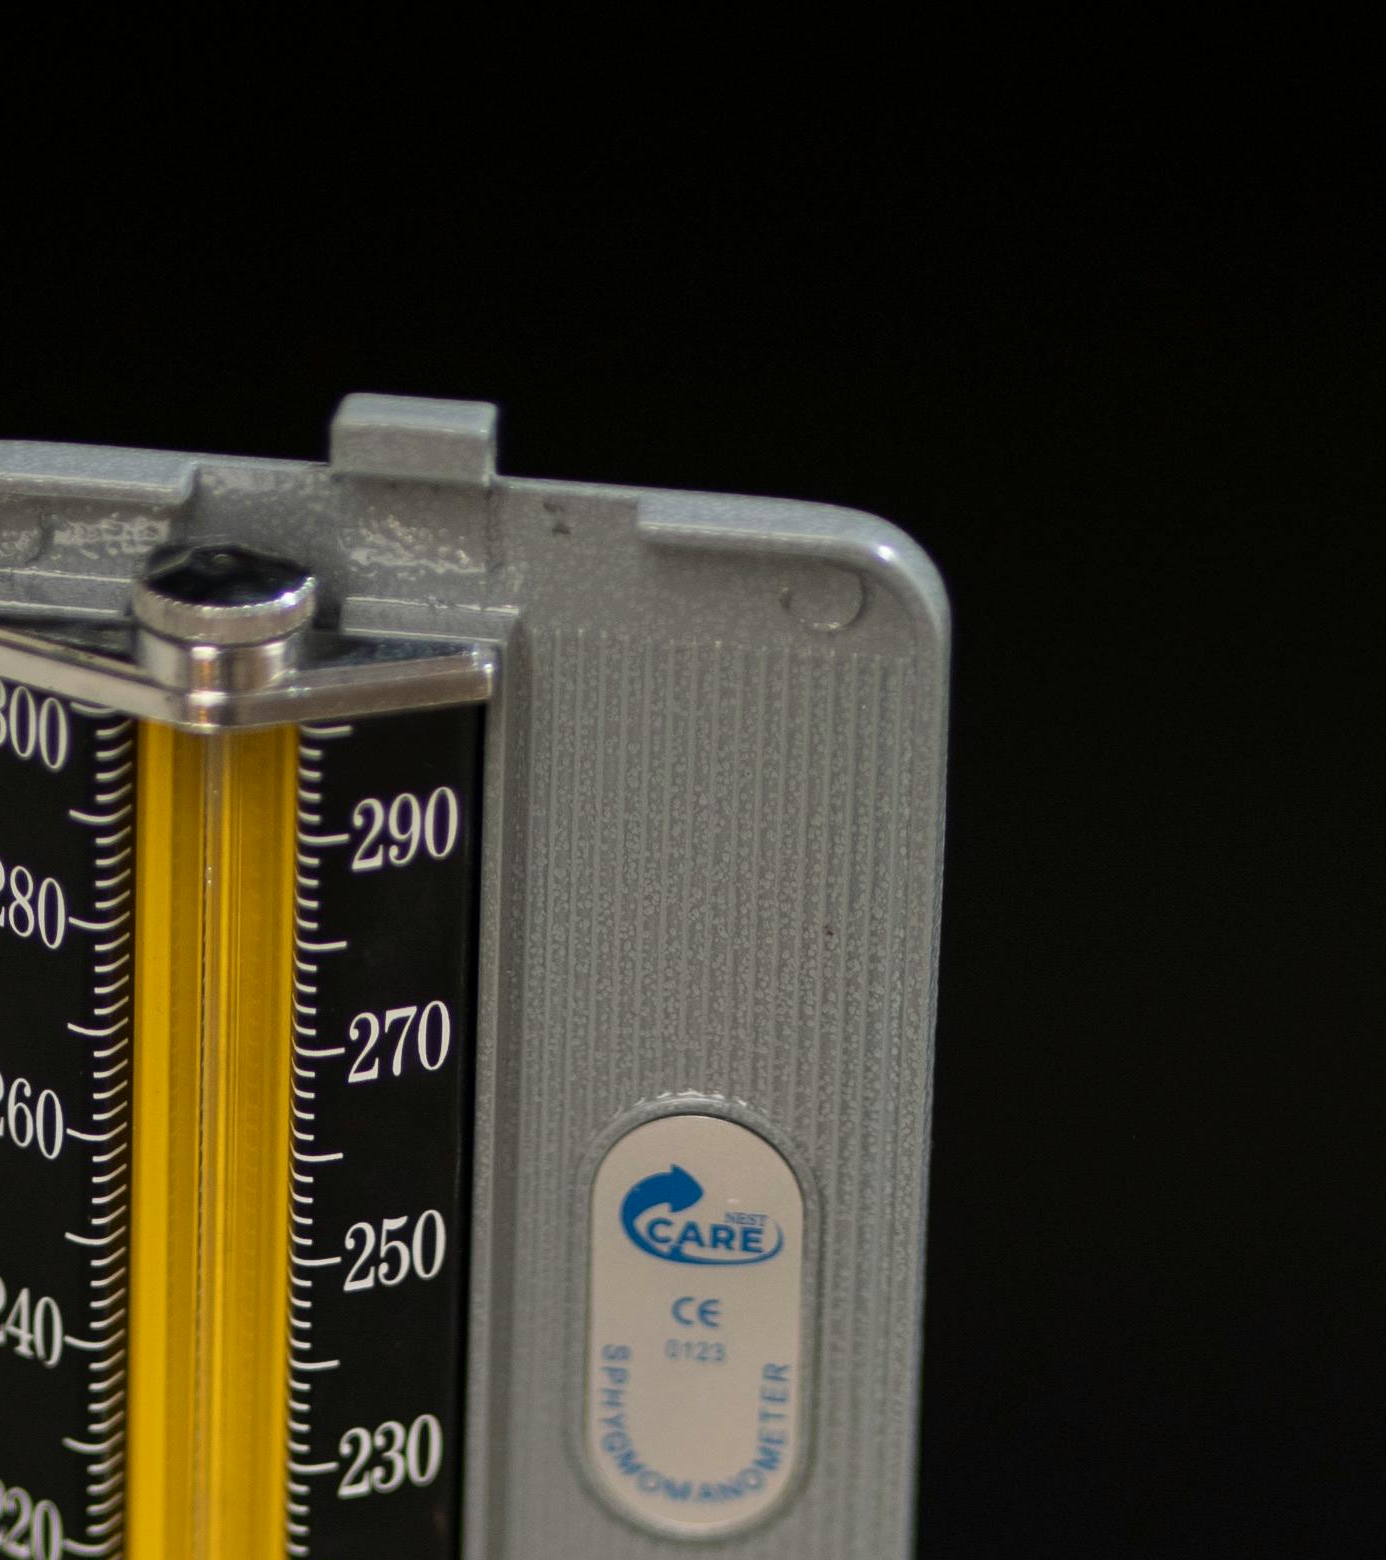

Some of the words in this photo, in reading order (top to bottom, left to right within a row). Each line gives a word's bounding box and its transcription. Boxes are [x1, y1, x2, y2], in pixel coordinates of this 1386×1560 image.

[351, 785, 459, 872] 290
[348, 1001, 451, 1083] 270
[343, 1209, 447, 1292] 250
[646, 1217, 766, 1254] CARE
[338, 1415, 442, 1499] 230
